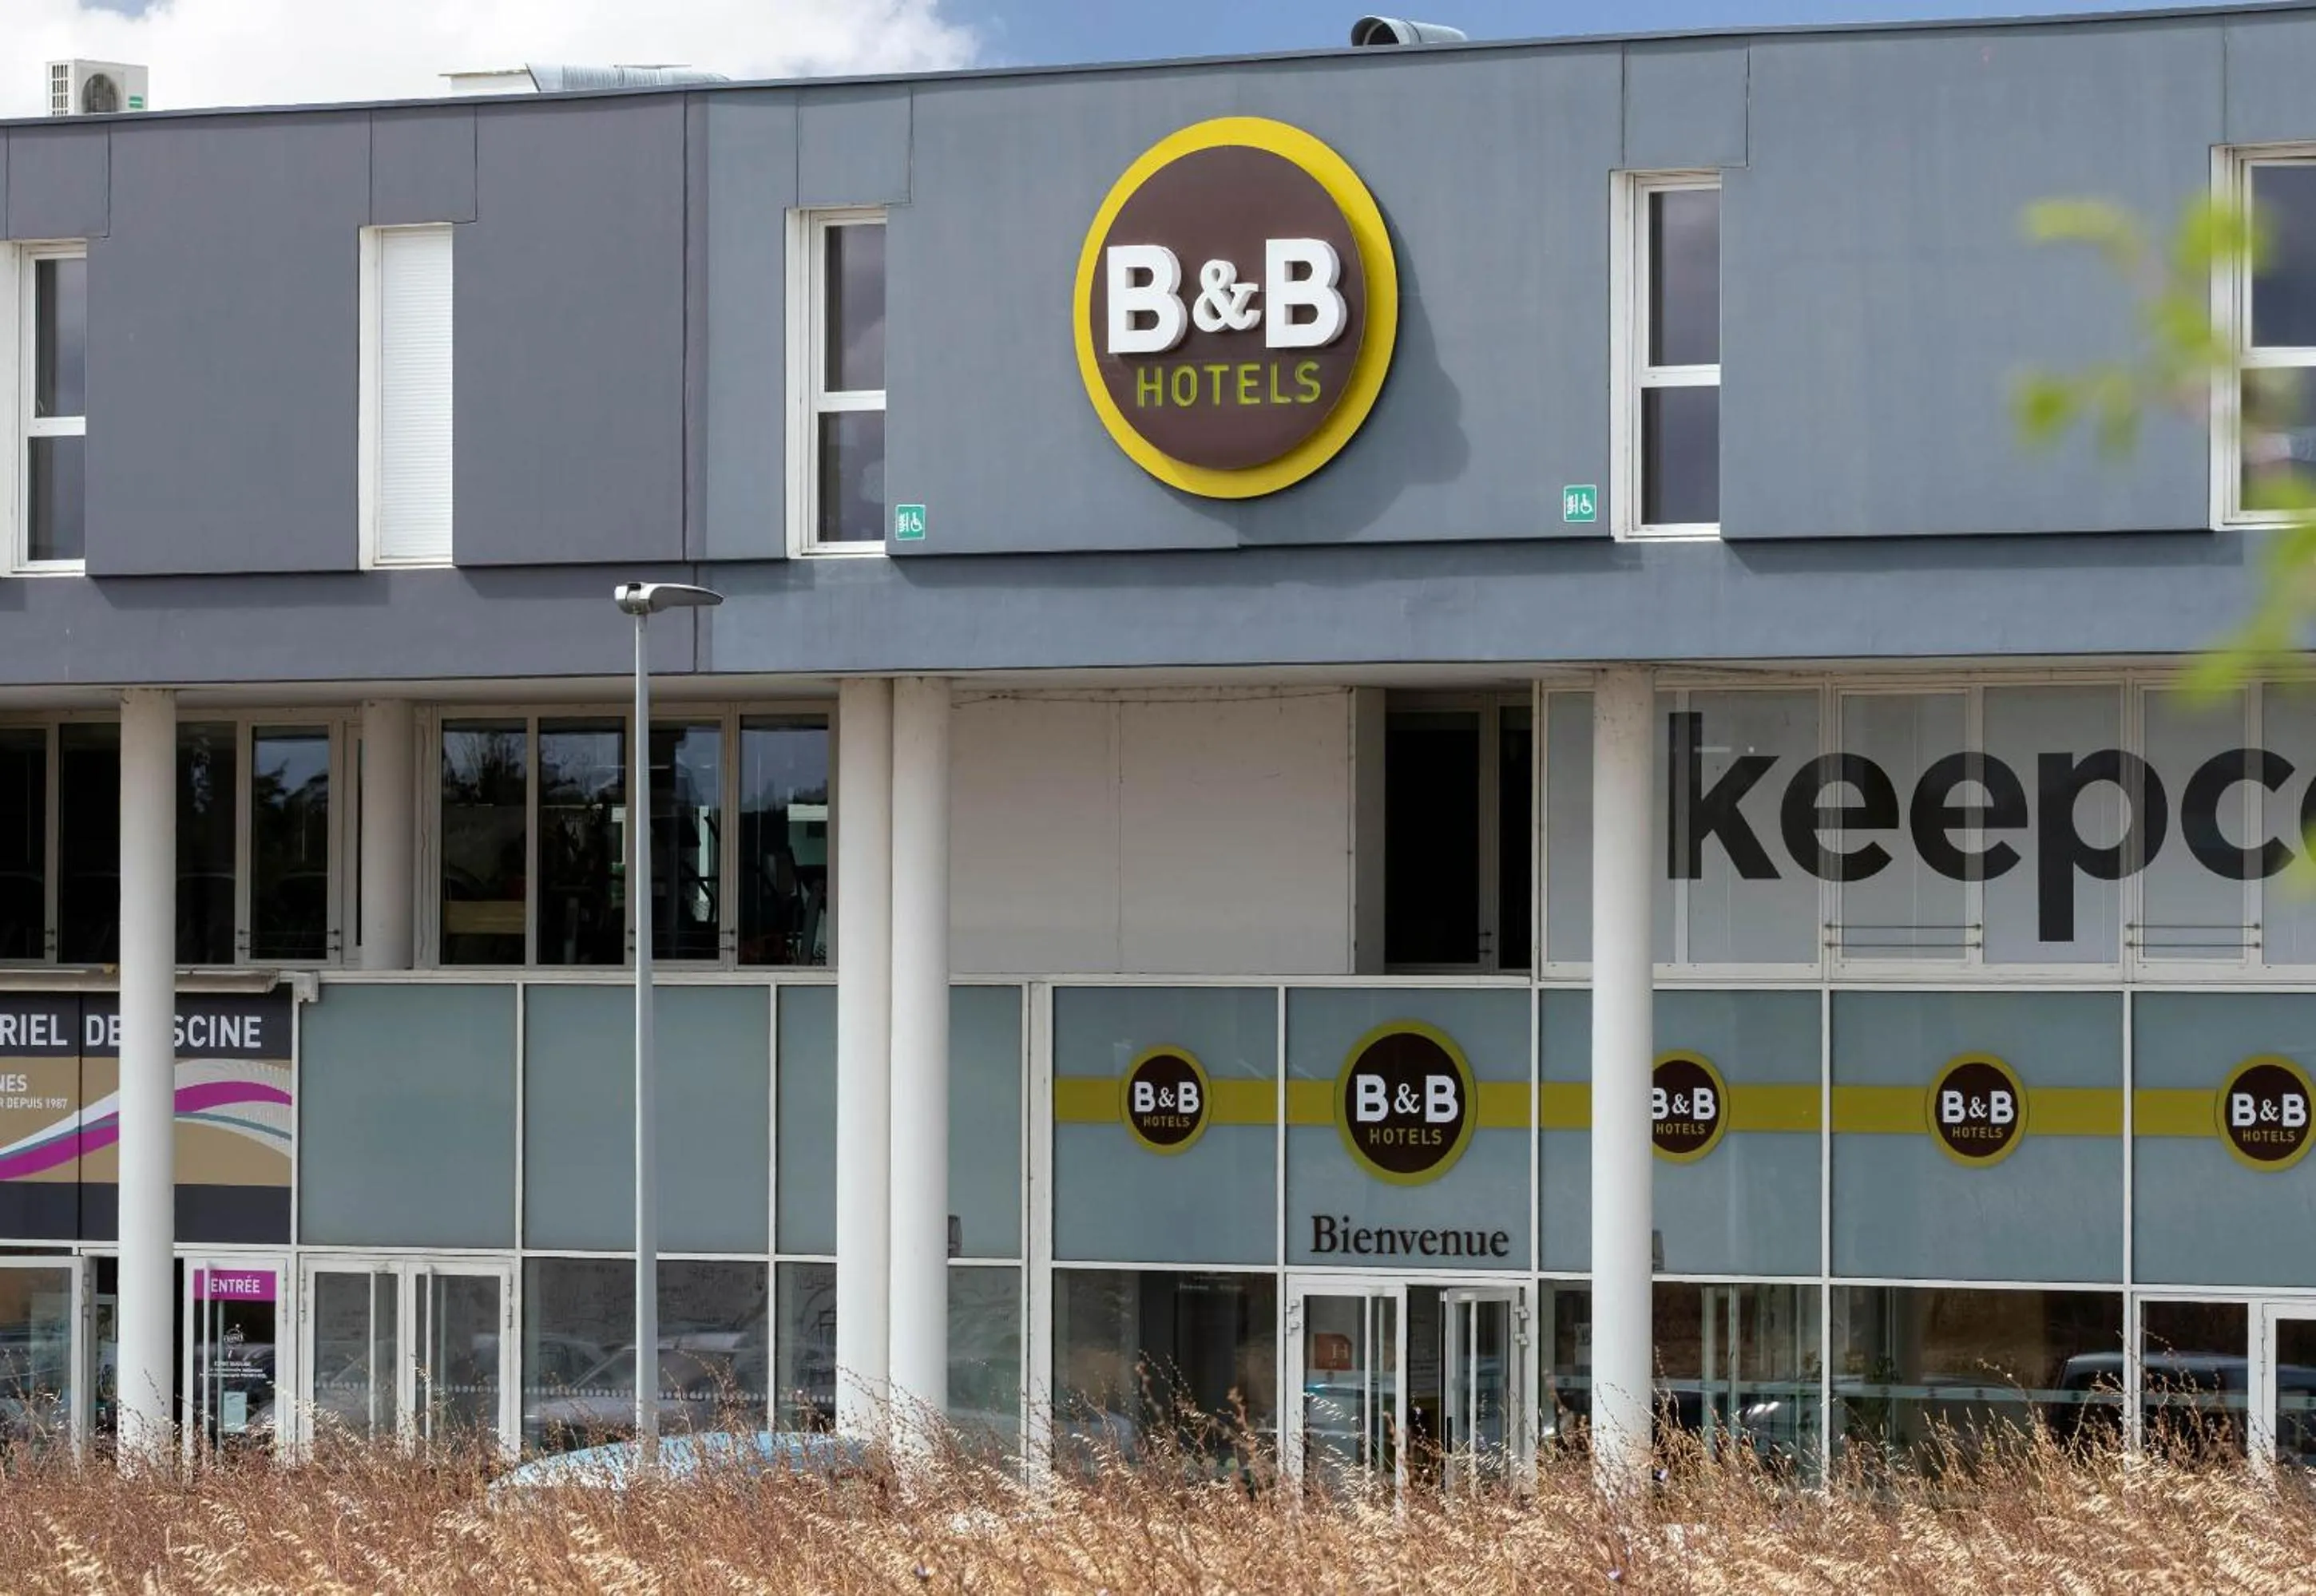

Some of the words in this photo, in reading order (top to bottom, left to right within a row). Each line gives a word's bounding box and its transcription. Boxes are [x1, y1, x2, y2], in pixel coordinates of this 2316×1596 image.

[1107, 238, 1347, 354] B&B
[1137, 360, 1321, 407] HOTELS
[1668, 711, 2316, 942] keepc
[174, 1015, 262, 1048] SCINE
[7, 1096, 42, 1110] DEPUIS
[1135, 1081, 1200, 1114] B&B
[1356, 1074, 1459, 1123] B&B
[1652, 1087, 1716, 1120] B&B
[1942, 1091, 2014, 1124] B&B
[2231, 1093, 2306, 1127] B&B
[1144, 1115, 1190, 1128] HOTELS
[1369, 1127, 1442, 1147] HOTELS
[1656, 1123, 1706, 1135] HOTELS
[1952, 1127, 2004, 1139] HOTELS
[2243, 1130, 2295, 1143] HOTELS
[1311, 1214, 1509, 1257] Bienvenue
[211, 1276, 260, 1293] ENTRÉE
